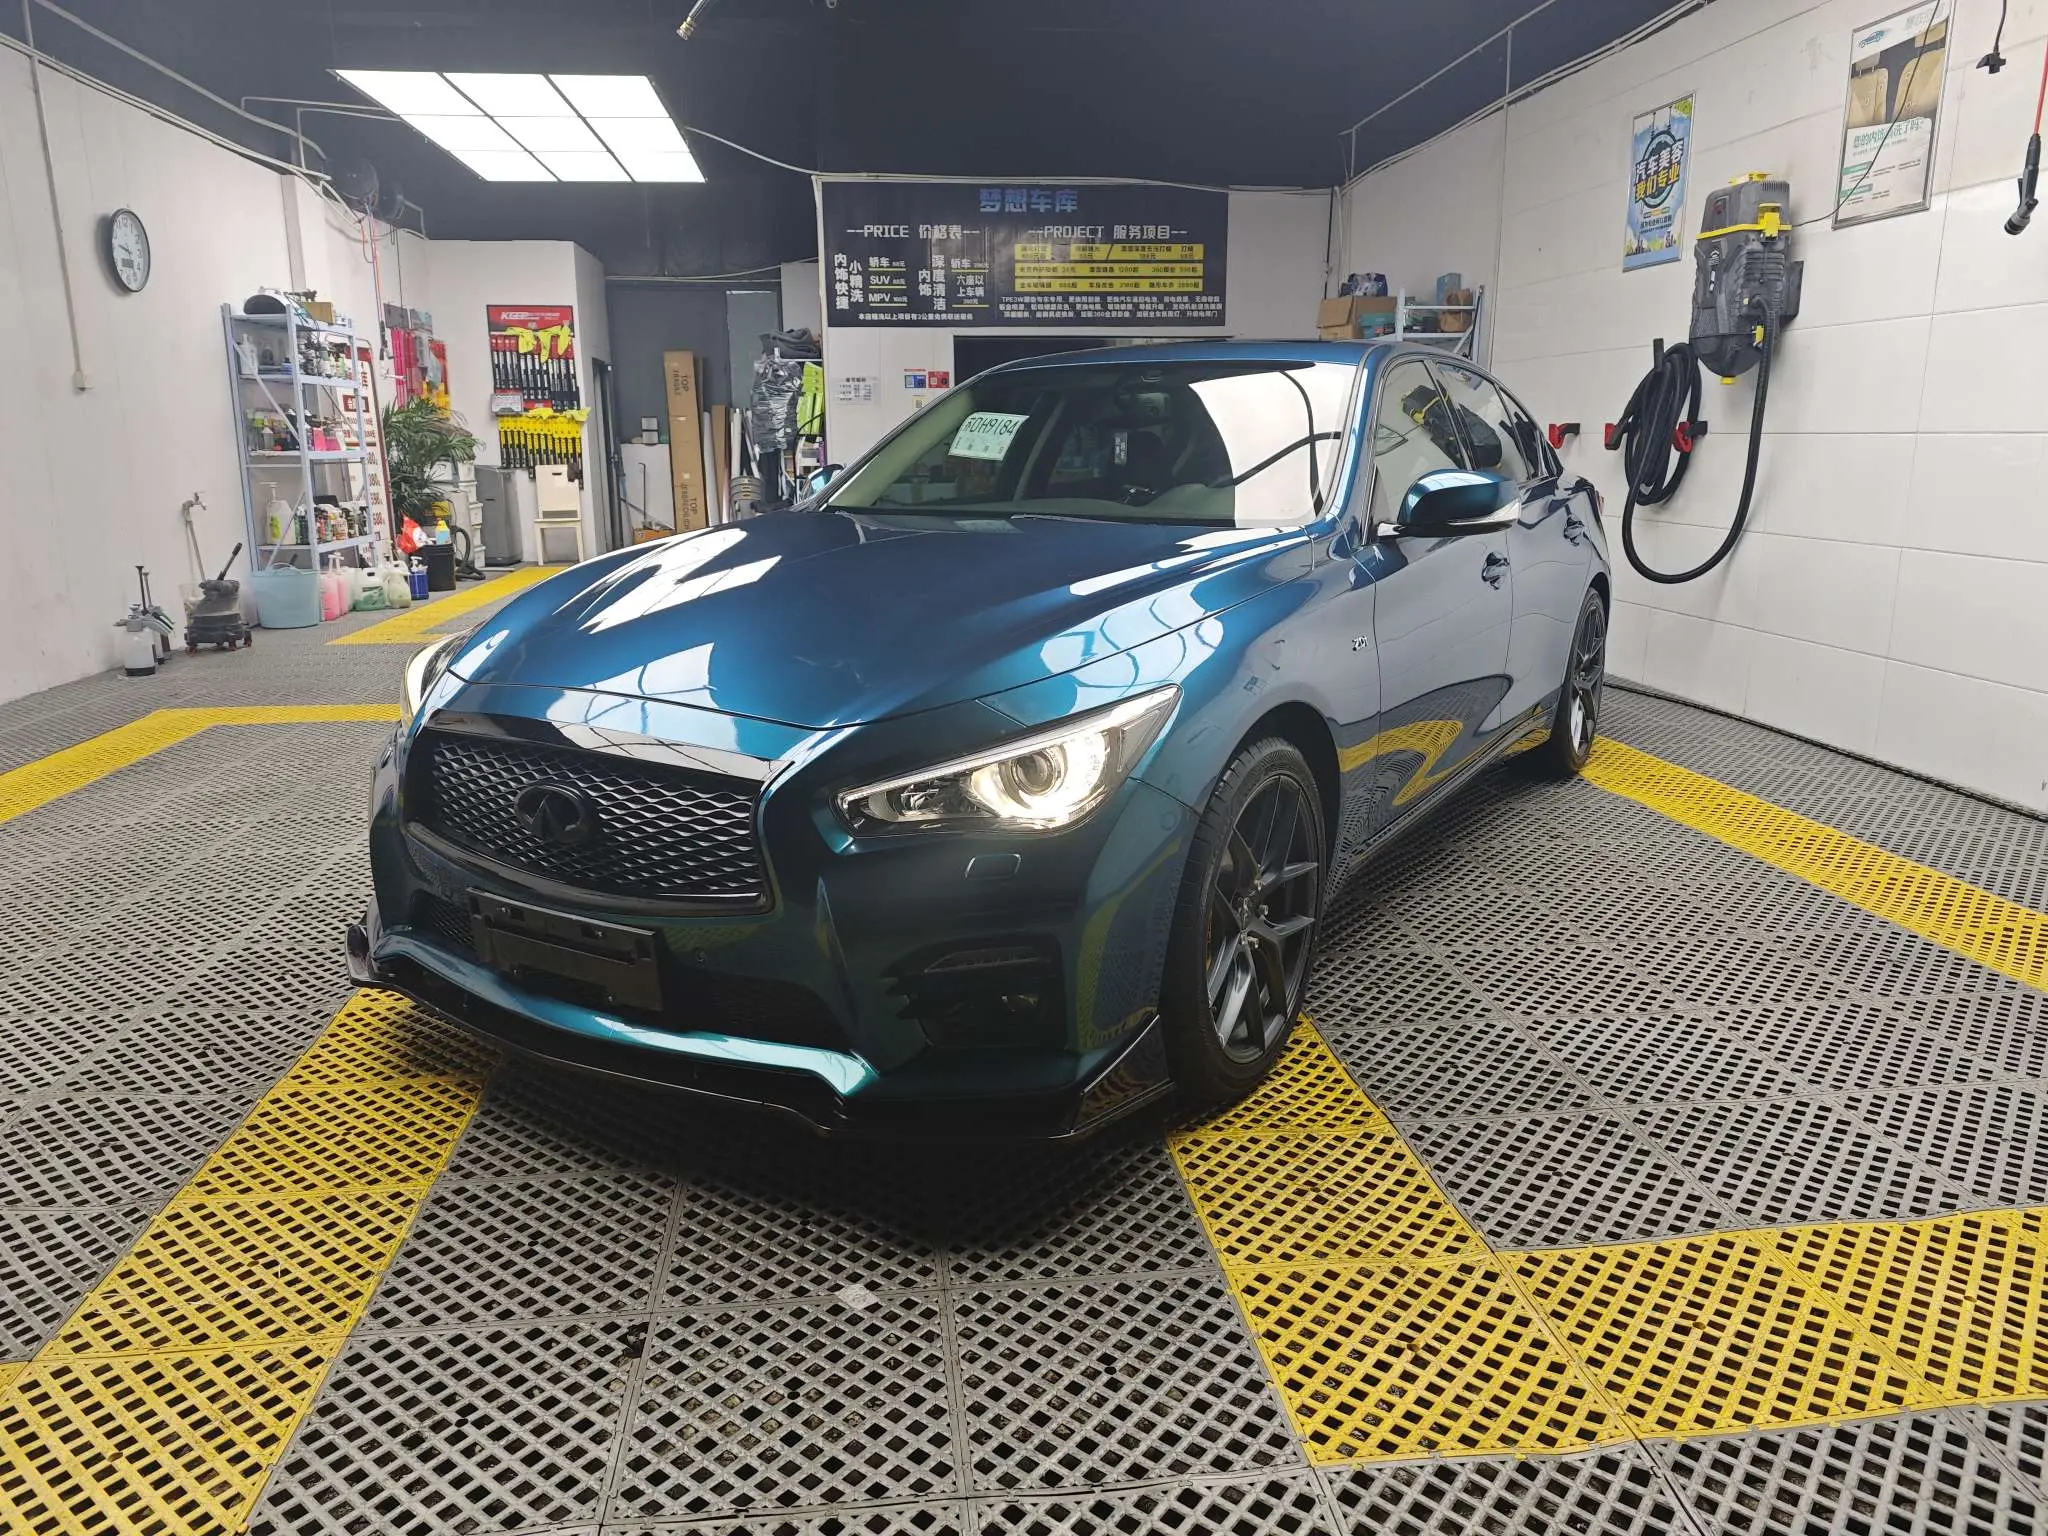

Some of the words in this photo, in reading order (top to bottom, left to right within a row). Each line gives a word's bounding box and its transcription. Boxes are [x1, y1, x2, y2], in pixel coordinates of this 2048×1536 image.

[1636, 140, 1683, 184] 汽车美容
[1635, 163, 1680, 200] 我们专业
[980, 188, 1077, 213] 梦想车库
[863, 225, 909, 238] PRICE
[919, 225, 962, 239] 价格表
[1044, 225, 1104, 238] PROJECT
[1113, 225, 1171, 239] 服务项目
[870, 276, 890, 285] SUV
[868, 293, 890, 303] MPV
